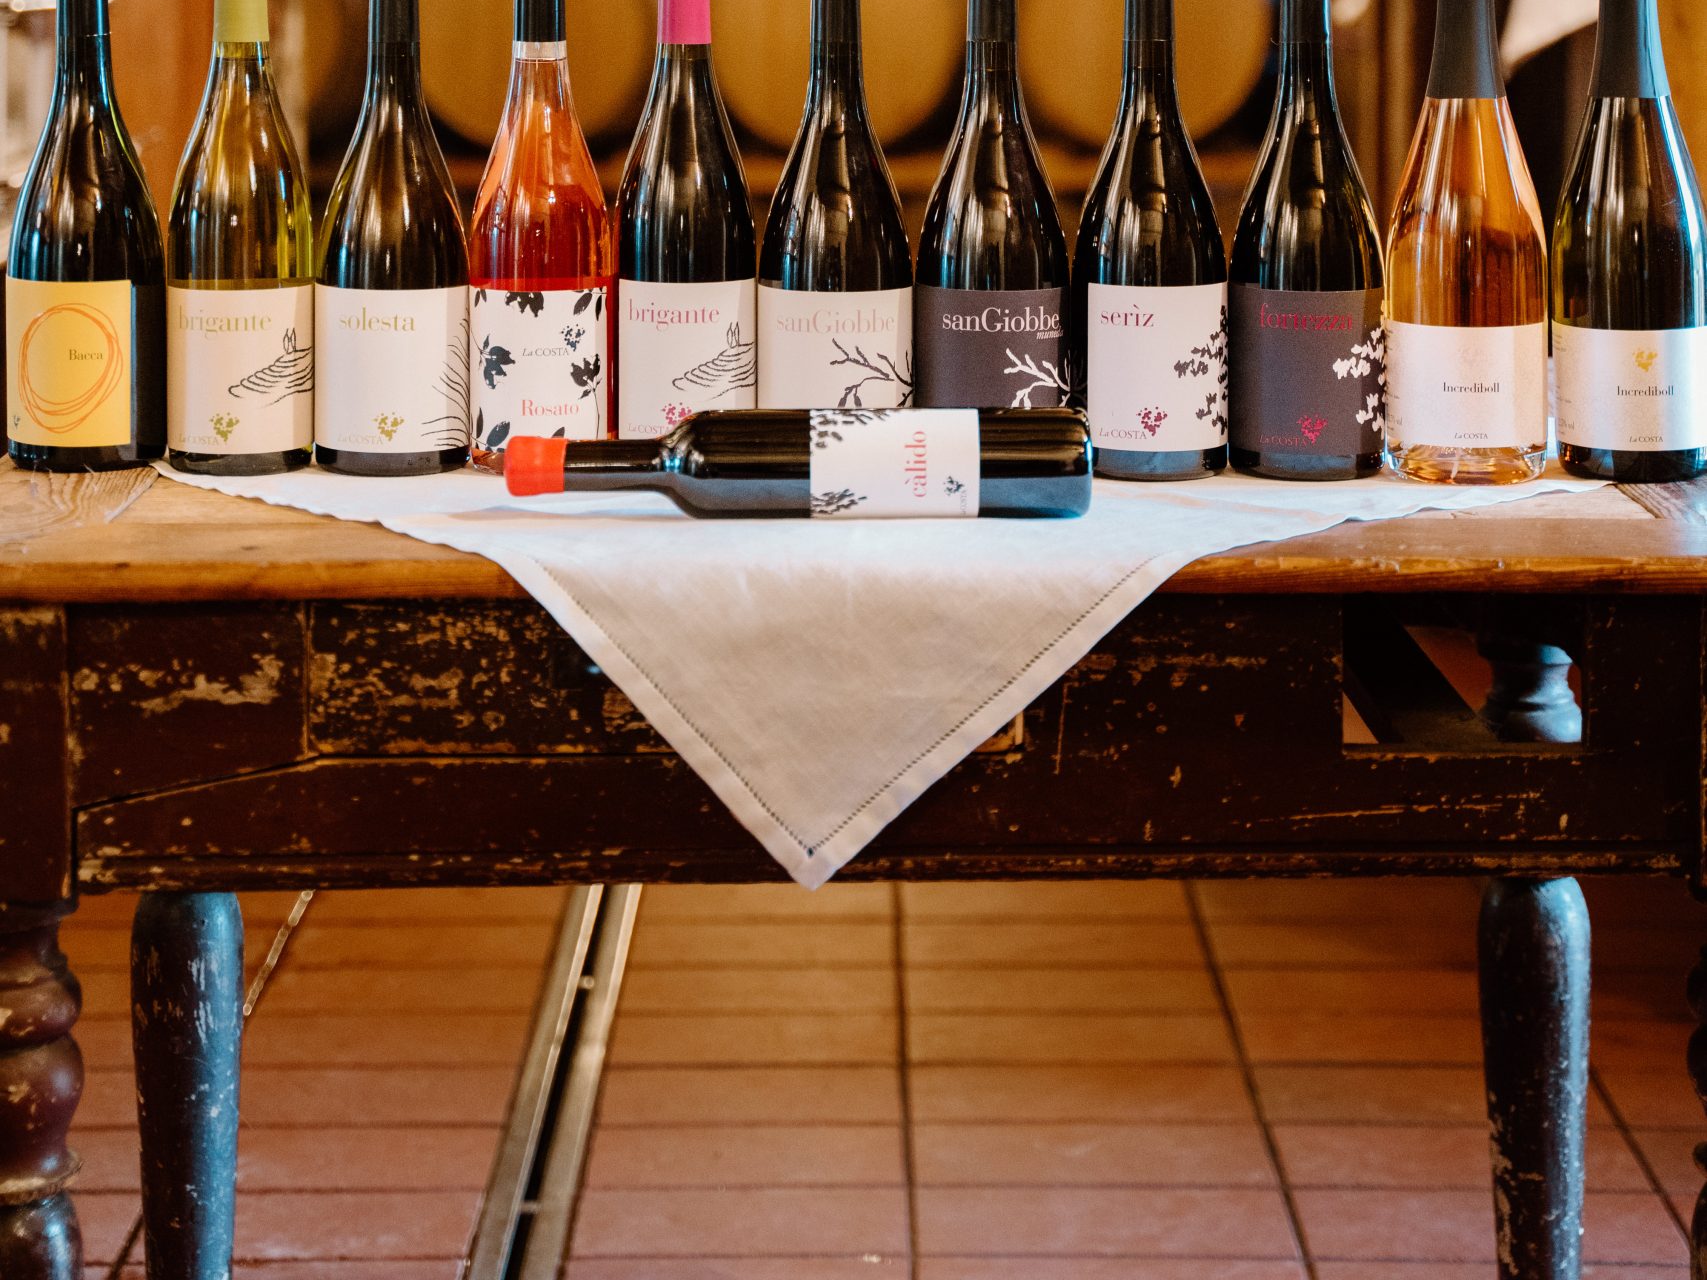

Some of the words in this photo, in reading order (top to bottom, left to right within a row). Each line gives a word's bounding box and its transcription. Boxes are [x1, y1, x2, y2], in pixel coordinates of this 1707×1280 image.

[179, 304, 272, 341] brigante
[338, 307, 415, 332] solesta
[629, 298, 720, 332] brigante
[776, 308, 895, 334] sanGiobbe
[942, 306, 1060, 332] sanGiobbe
[1100, 304, 1154, 328] serìz
[68, 349, 104, 361] Bacca
[535, 347, 570, 357] COSTA
[1443, 382, 1500, 394] Incrediboll
[1617, 386, 1674, 396] Incrediboll
[521, 399, 580, 416] Rosato
[1111, 429, 1148, 440] COSTA
[904, 431, 927, 498] càlido
